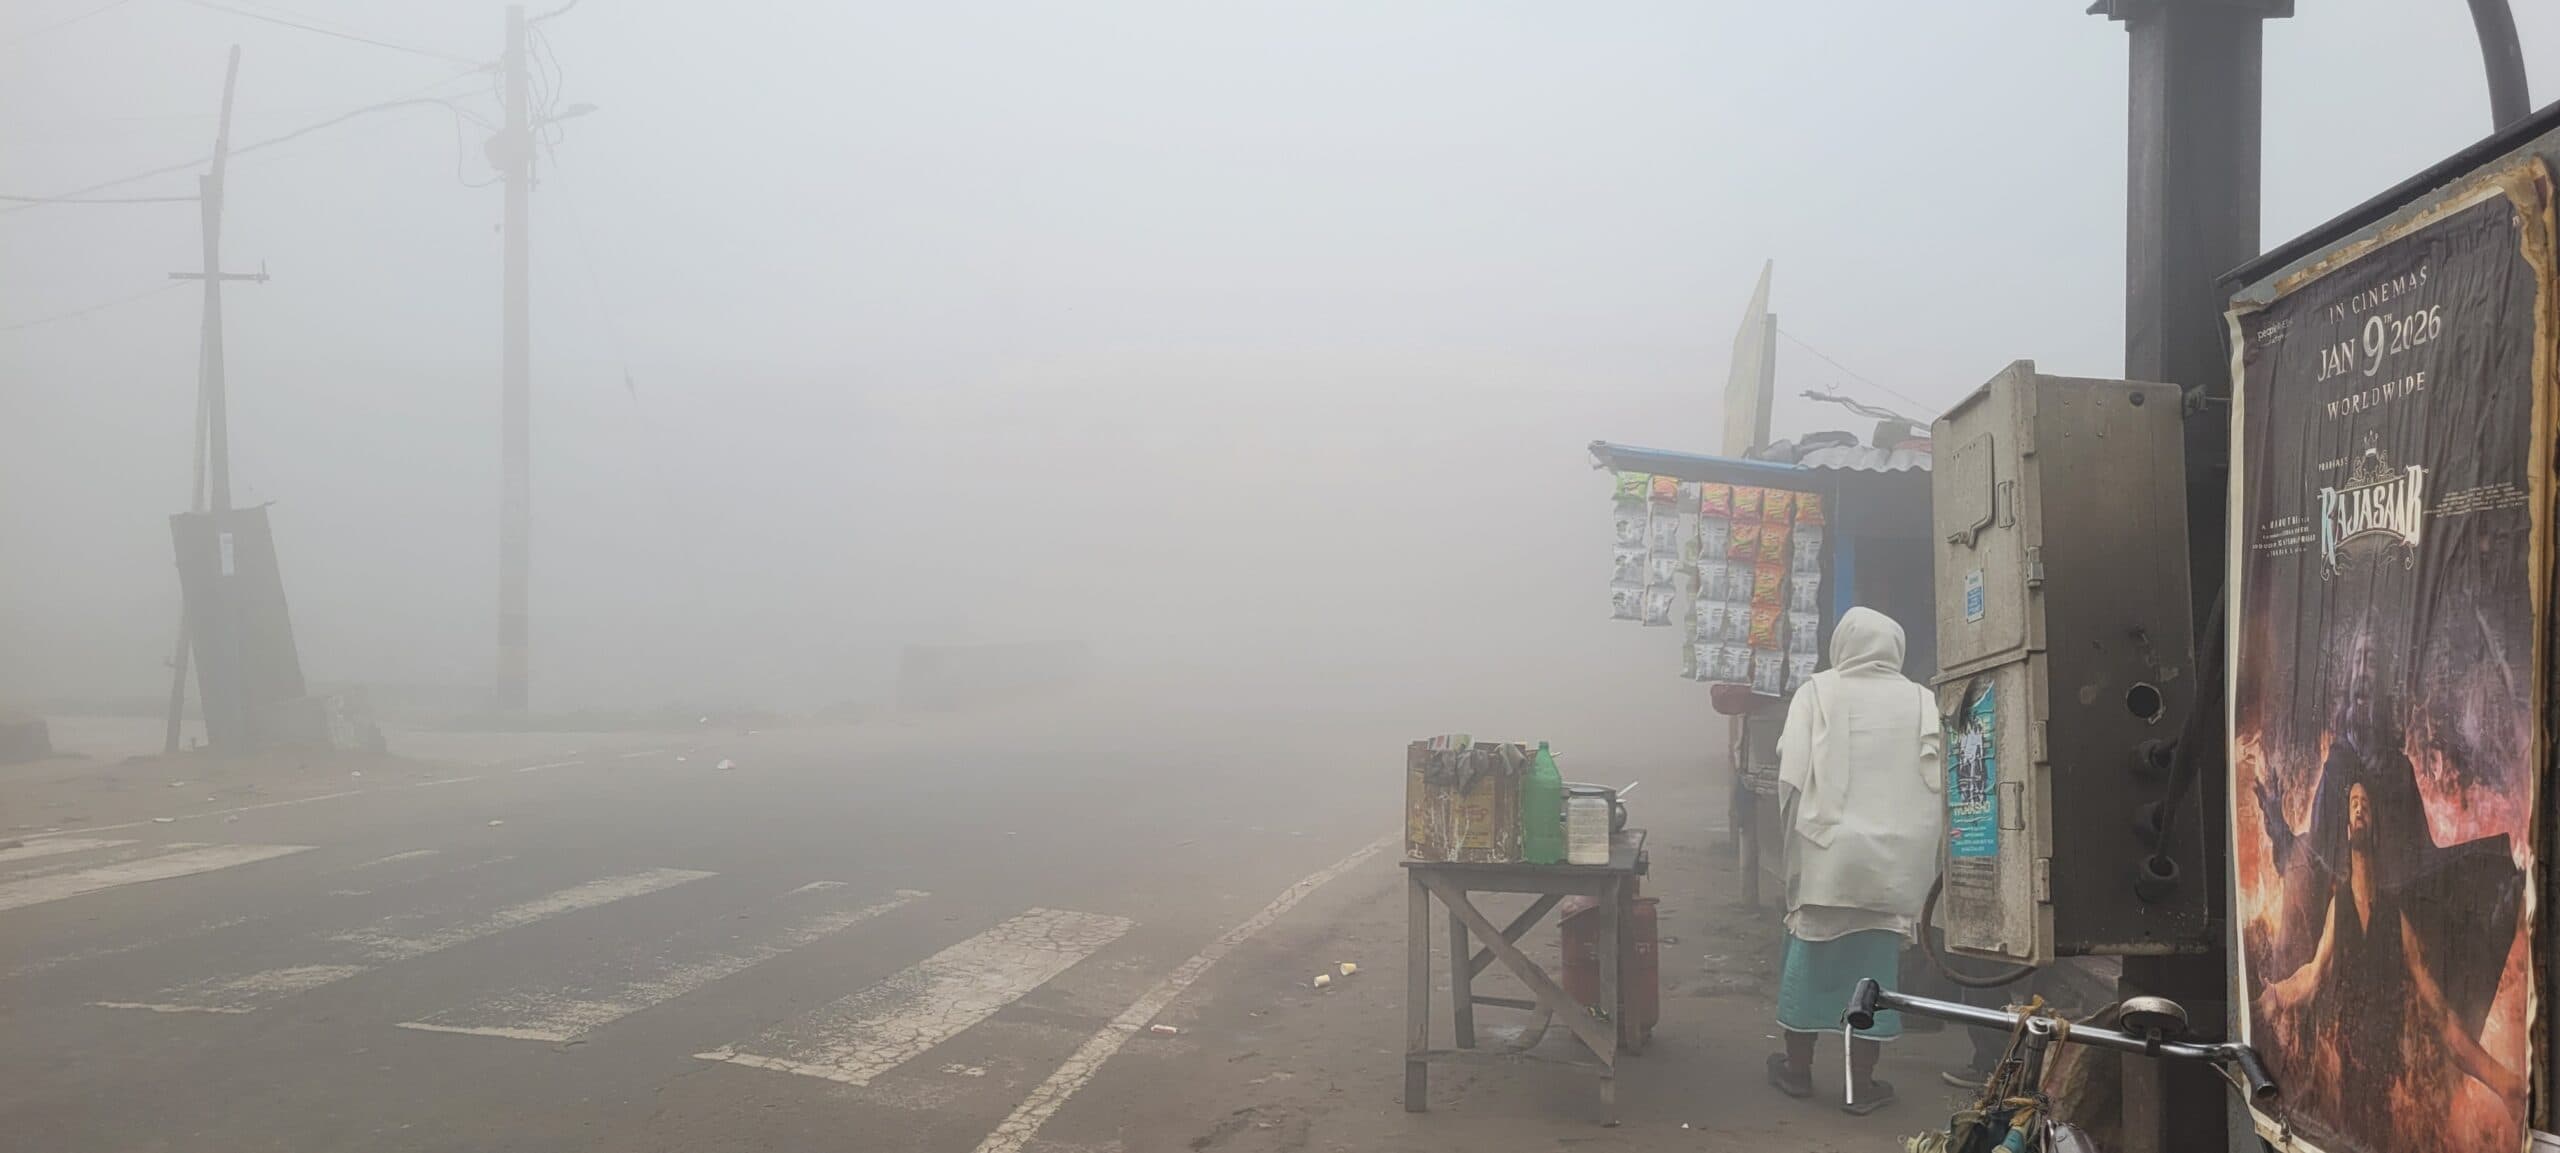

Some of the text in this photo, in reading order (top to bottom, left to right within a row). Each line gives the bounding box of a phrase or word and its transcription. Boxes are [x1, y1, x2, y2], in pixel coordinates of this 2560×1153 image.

[2329, 265, 2428, 325] IN CINEMAS
[2317, 338, 2356, 383] JAN
[2390, 304, 2441, 356] 2026
[2327, 371, 2426, 422] WORLDWIDE
[2319, 464, 2423, 566] RAJASAAB
